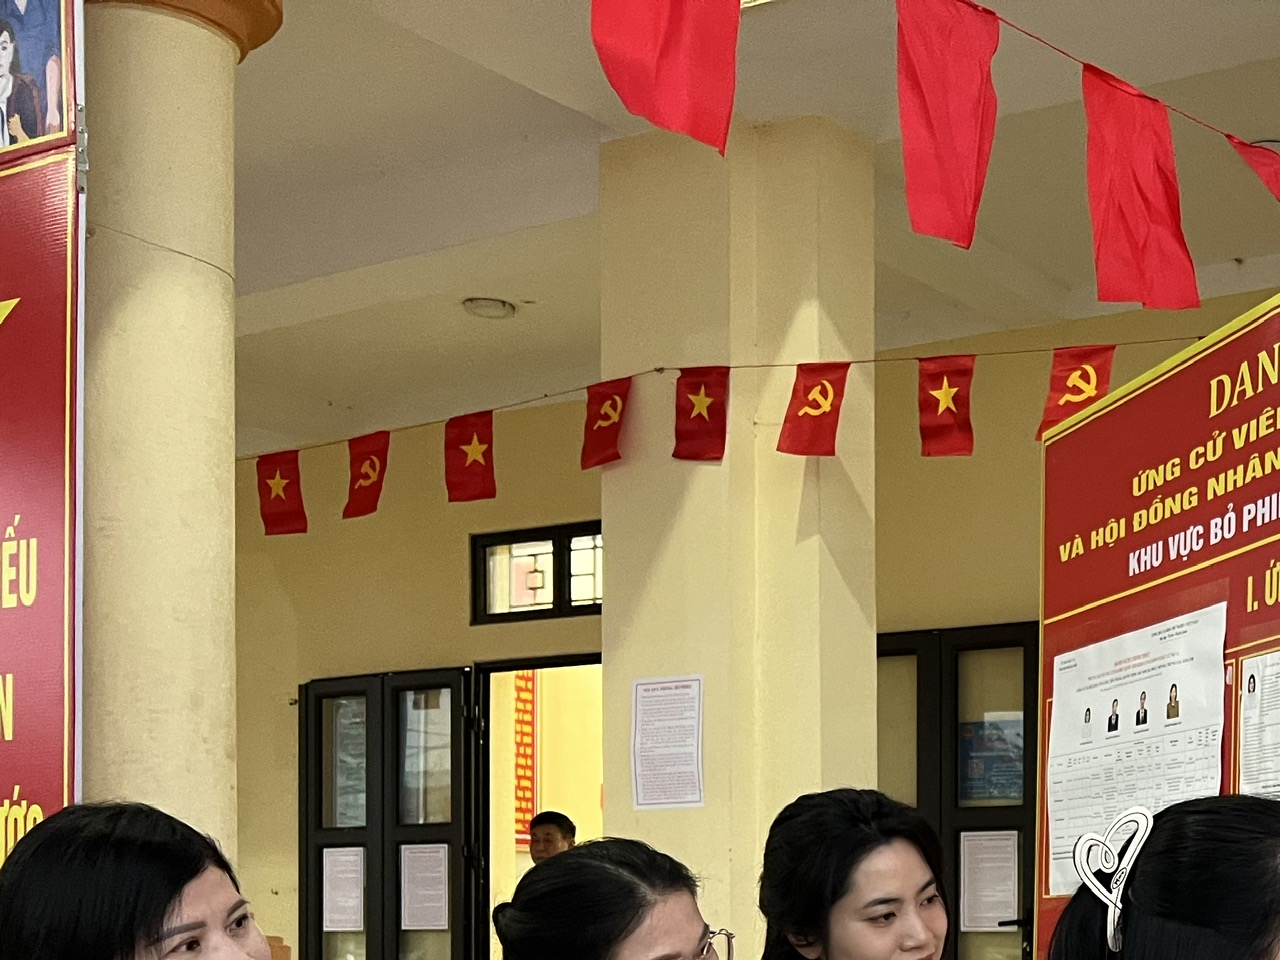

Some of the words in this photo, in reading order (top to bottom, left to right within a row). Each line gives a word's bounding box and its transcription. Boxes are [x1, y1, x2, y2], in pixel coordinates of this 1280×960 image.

[1132, 456, 1182, 497] ỨNG
[1190, 429, 1228, 470] CỬ
[1059, 536, 1085, 562] VÀ
[1090, 518, 1127, 551] HỘI
[1132, 486, 1199, 534] ĐỒNG
[1128, 540, 1164, 578] KHU
[1168, 525, 1205, 563] VỰC
[1210, 503, 1237, 546] BỎ
[1246, 575, 1259, 613] I.
